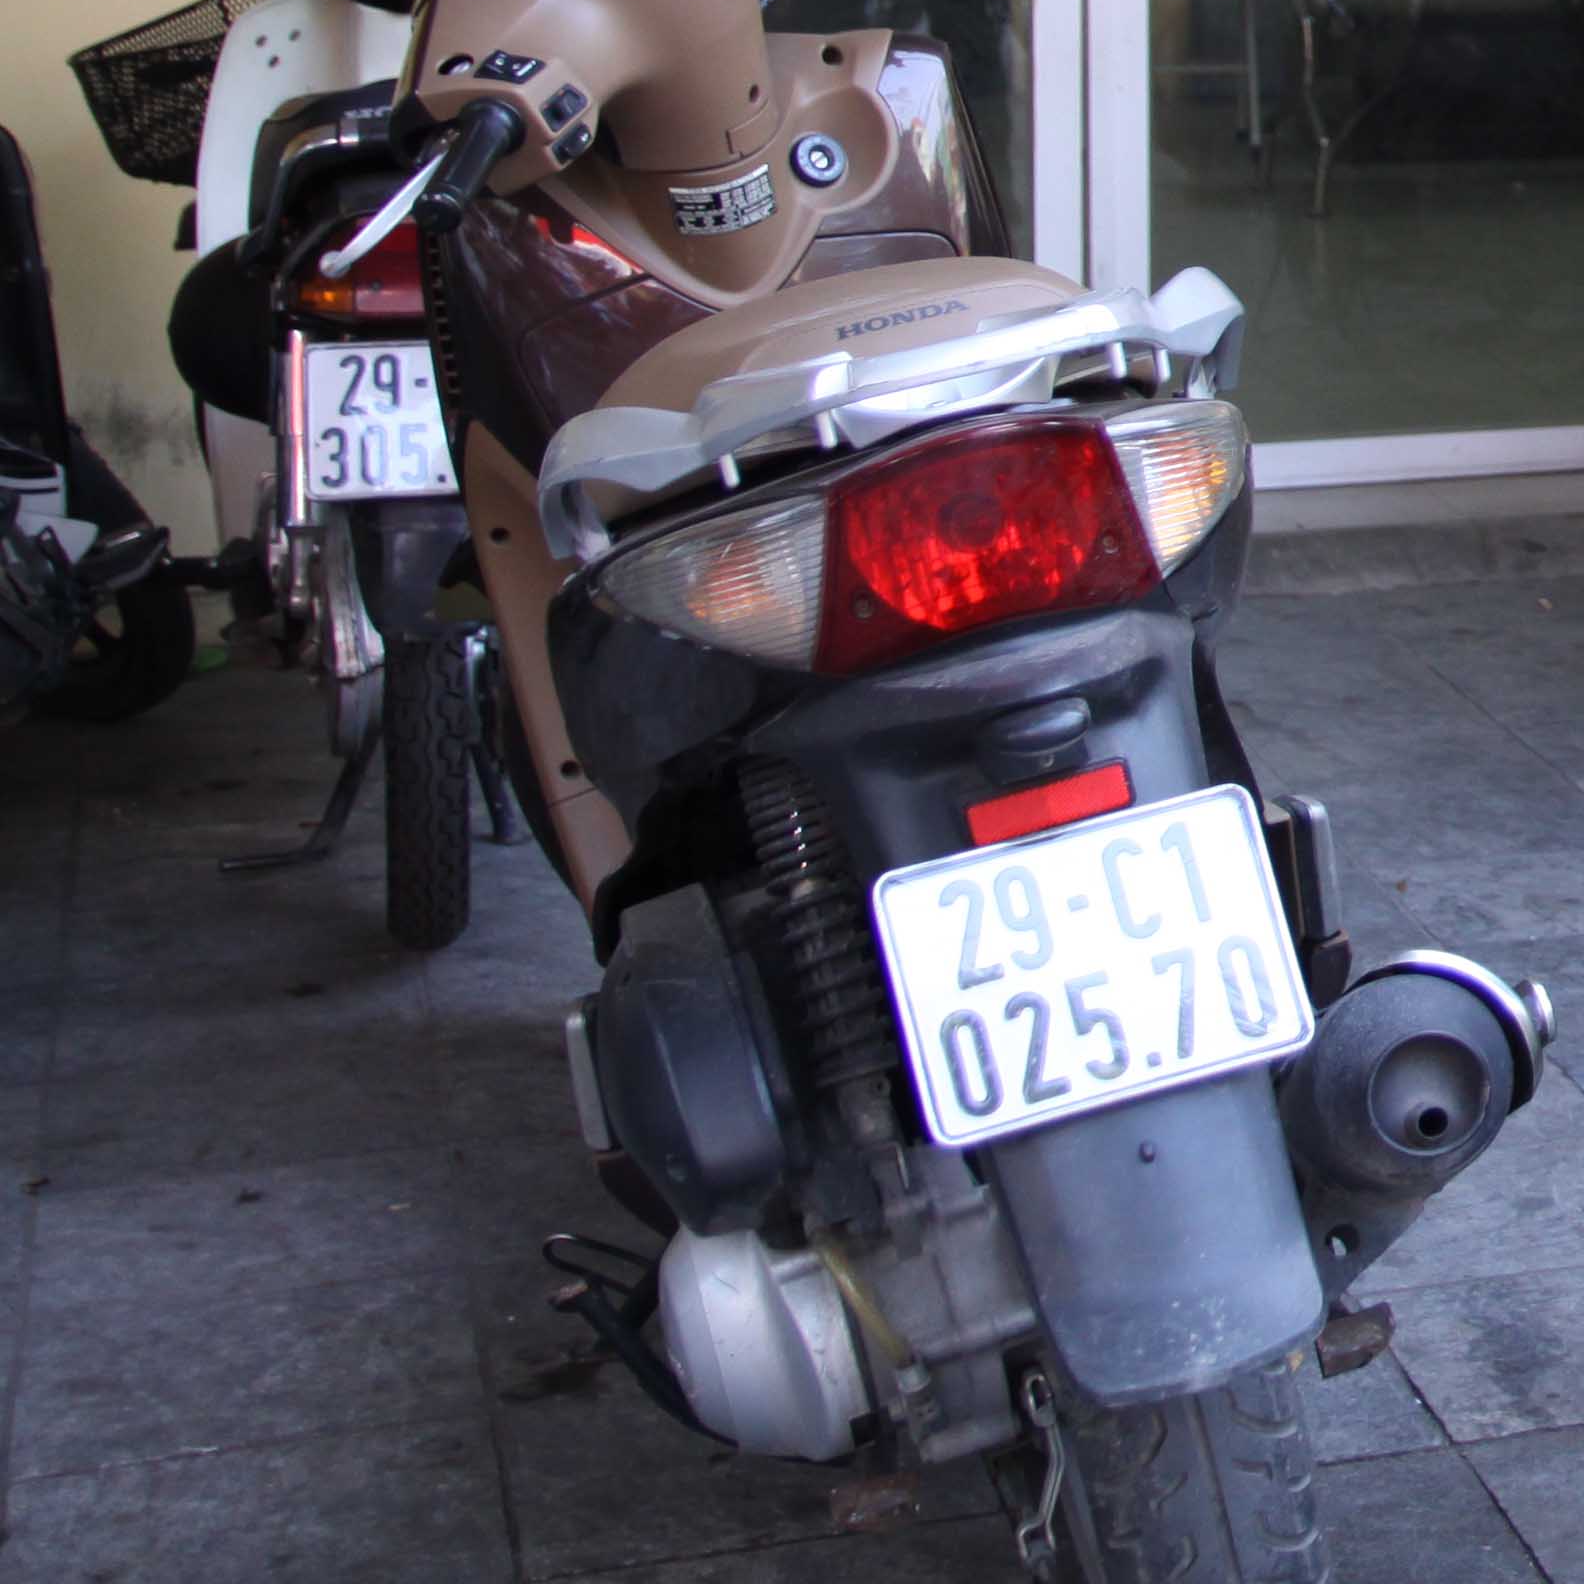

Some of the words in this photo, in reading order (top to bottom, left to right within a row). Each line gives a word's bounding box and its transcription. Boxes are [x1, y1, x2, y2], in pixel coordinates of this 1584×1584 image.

[835, 299, 972, 341] HONDA
[937, 822, 1213, 990] 29-C1
[938, 935, 1279, 1118] 025.70
